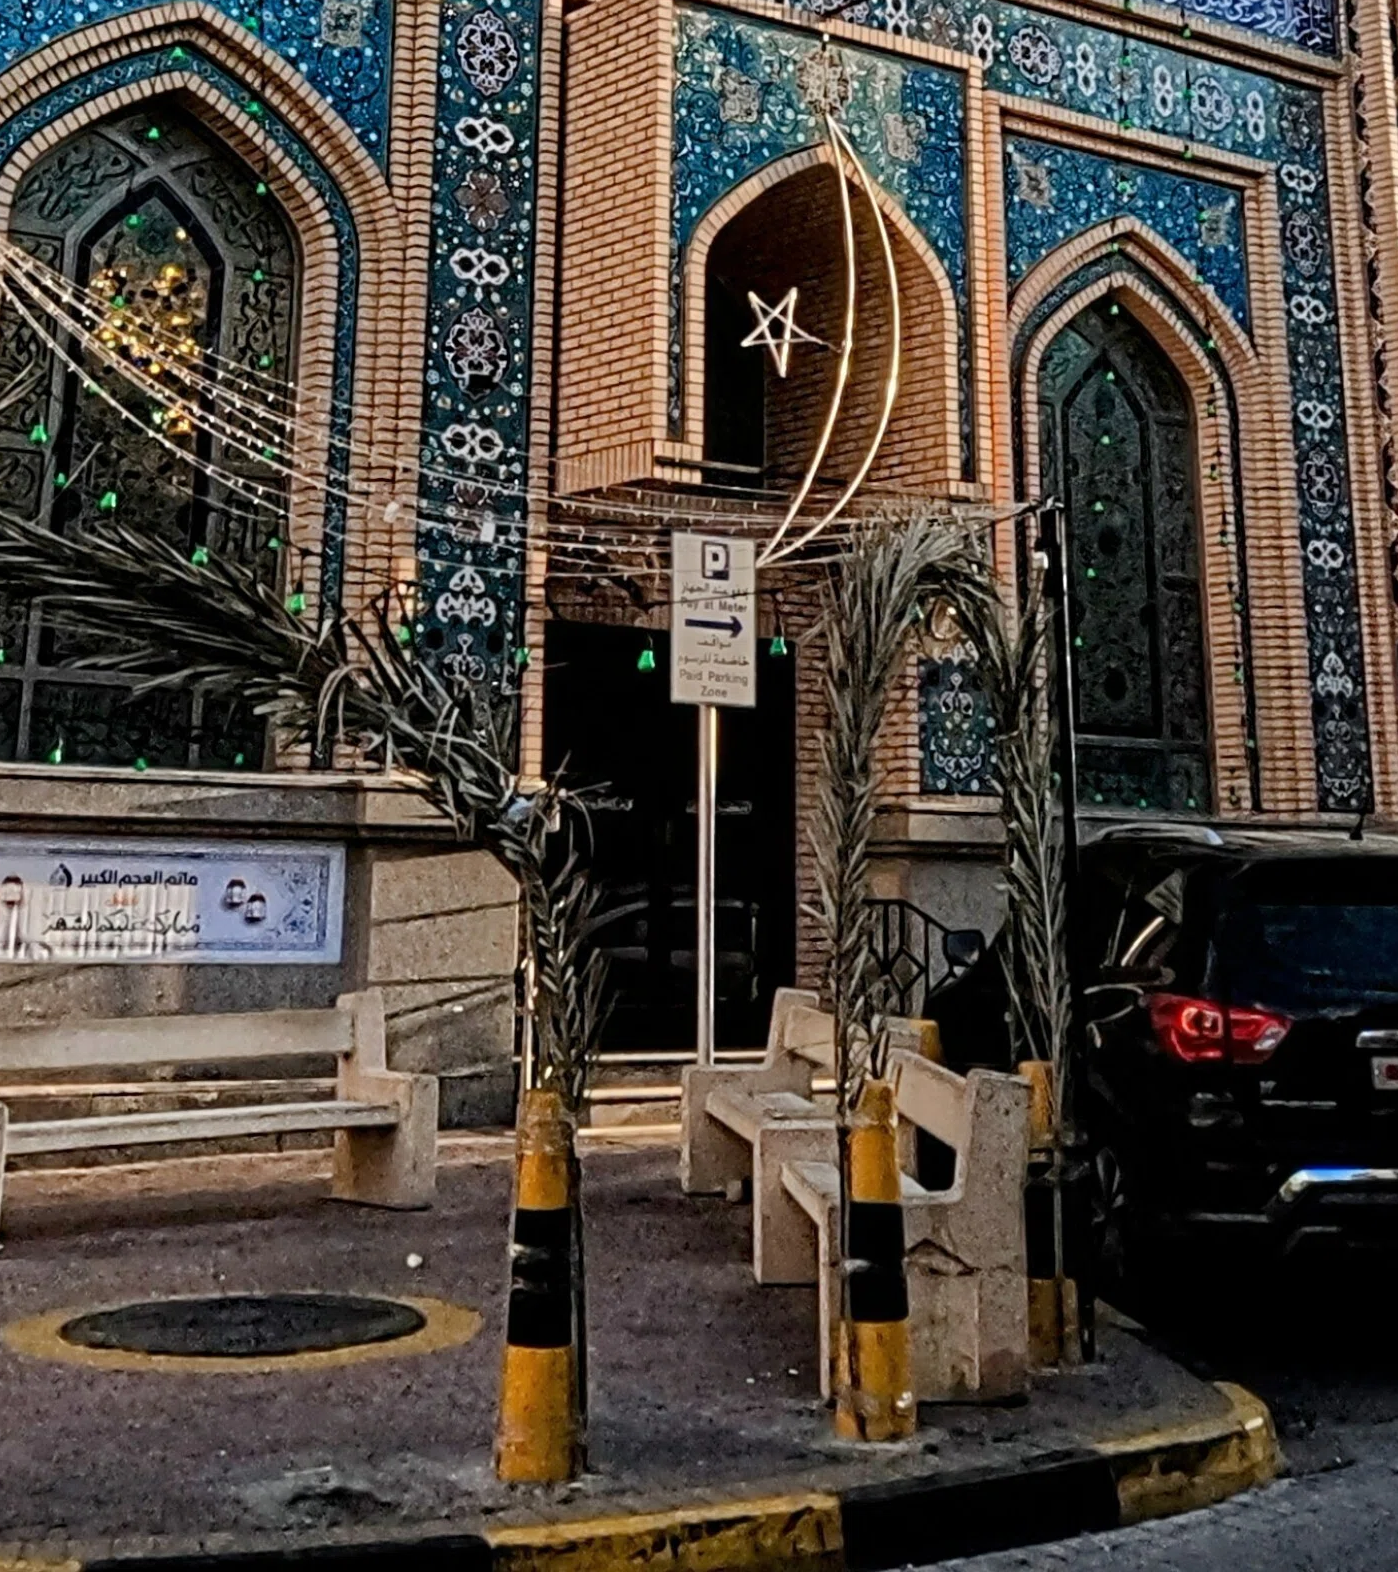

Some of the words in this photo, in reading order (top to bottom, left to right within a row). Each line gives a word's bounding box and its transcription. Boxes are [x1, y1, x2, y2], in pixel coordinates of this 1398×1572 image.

[718, 599, 748, 614] Meter
[679, 668, 704, 682] Paid
[707, 670, 750, 688] Parking
[700, 684, 728, 699] Zone
